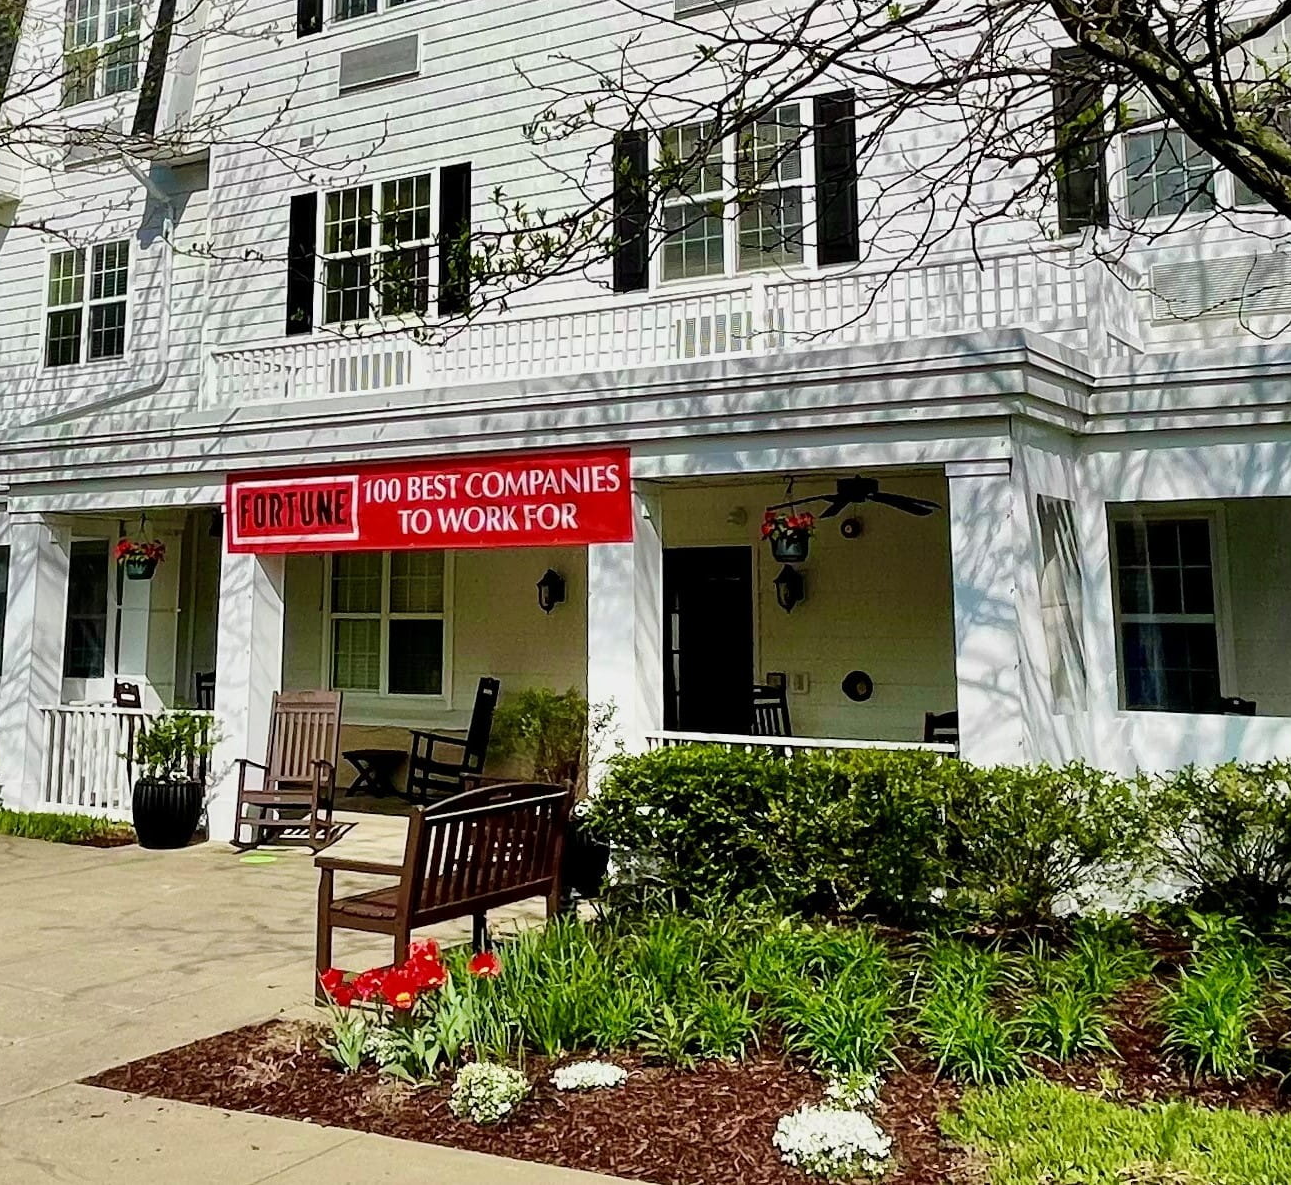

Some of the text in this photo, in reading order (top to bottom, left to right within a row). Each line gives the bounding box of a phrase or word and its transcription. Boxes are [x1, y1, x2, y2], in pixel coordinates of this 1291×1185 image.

[363, 464, 621, 504] 100 BEST COMPANIES
[240, 488, 349, 530] FORTUNE
[397, 503, 579, 534] TO WORK FOR
